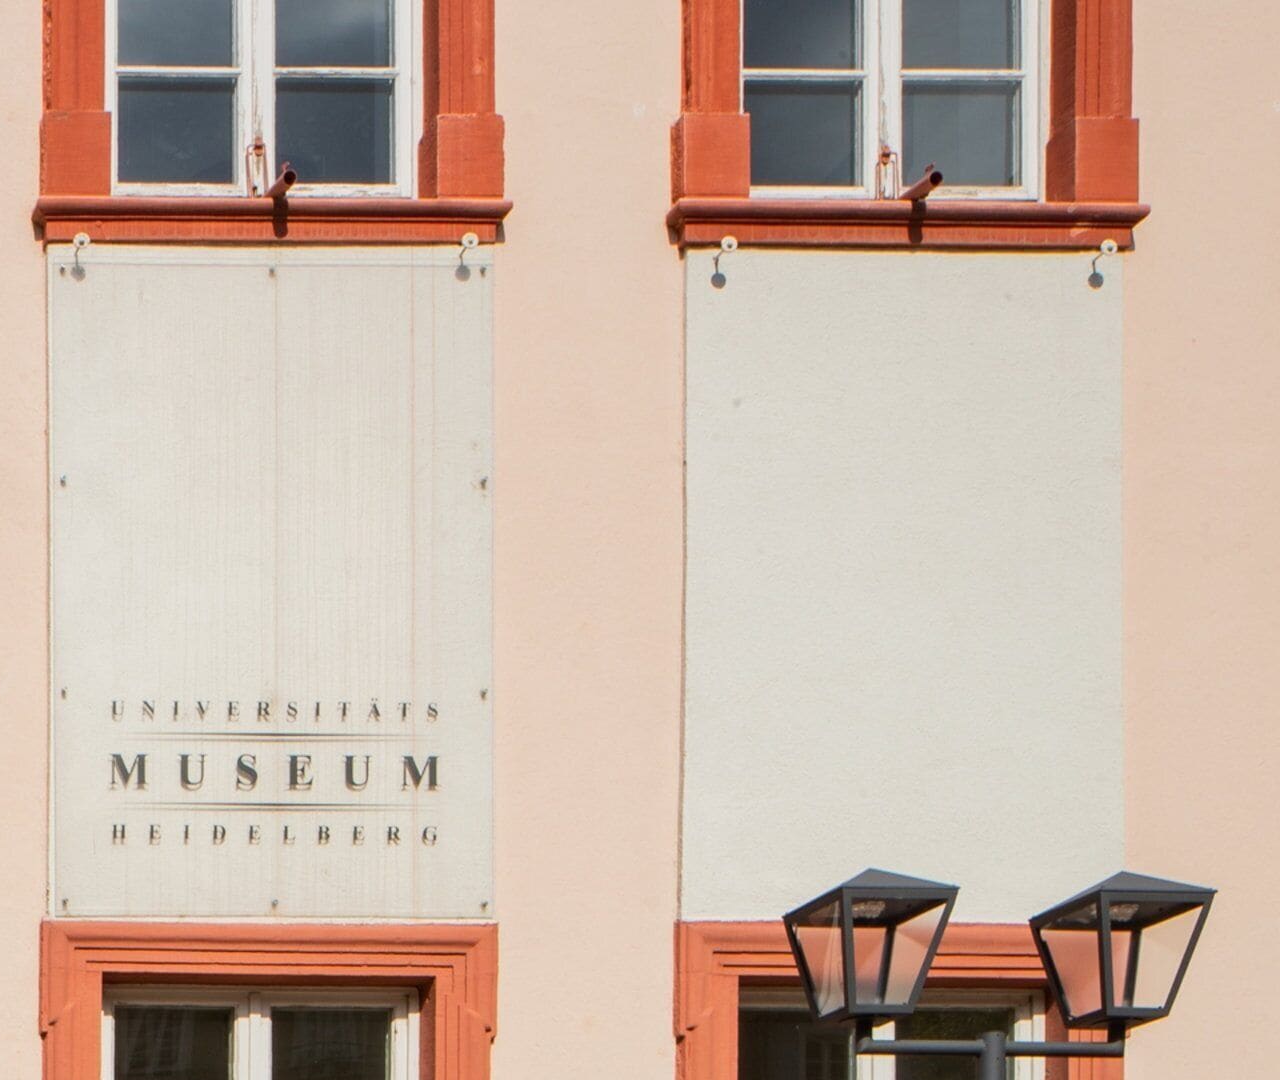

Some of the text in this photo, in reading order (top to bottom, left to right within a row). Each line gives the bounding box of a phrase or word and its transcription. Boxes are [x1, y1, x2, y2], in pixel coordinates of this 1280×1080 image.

[111, 698, 439, 719] UNIVERSITÄTS
[109, 753, 440, 788] MUSEUM
[112, 824, 438, 844] HEIDELBERG
